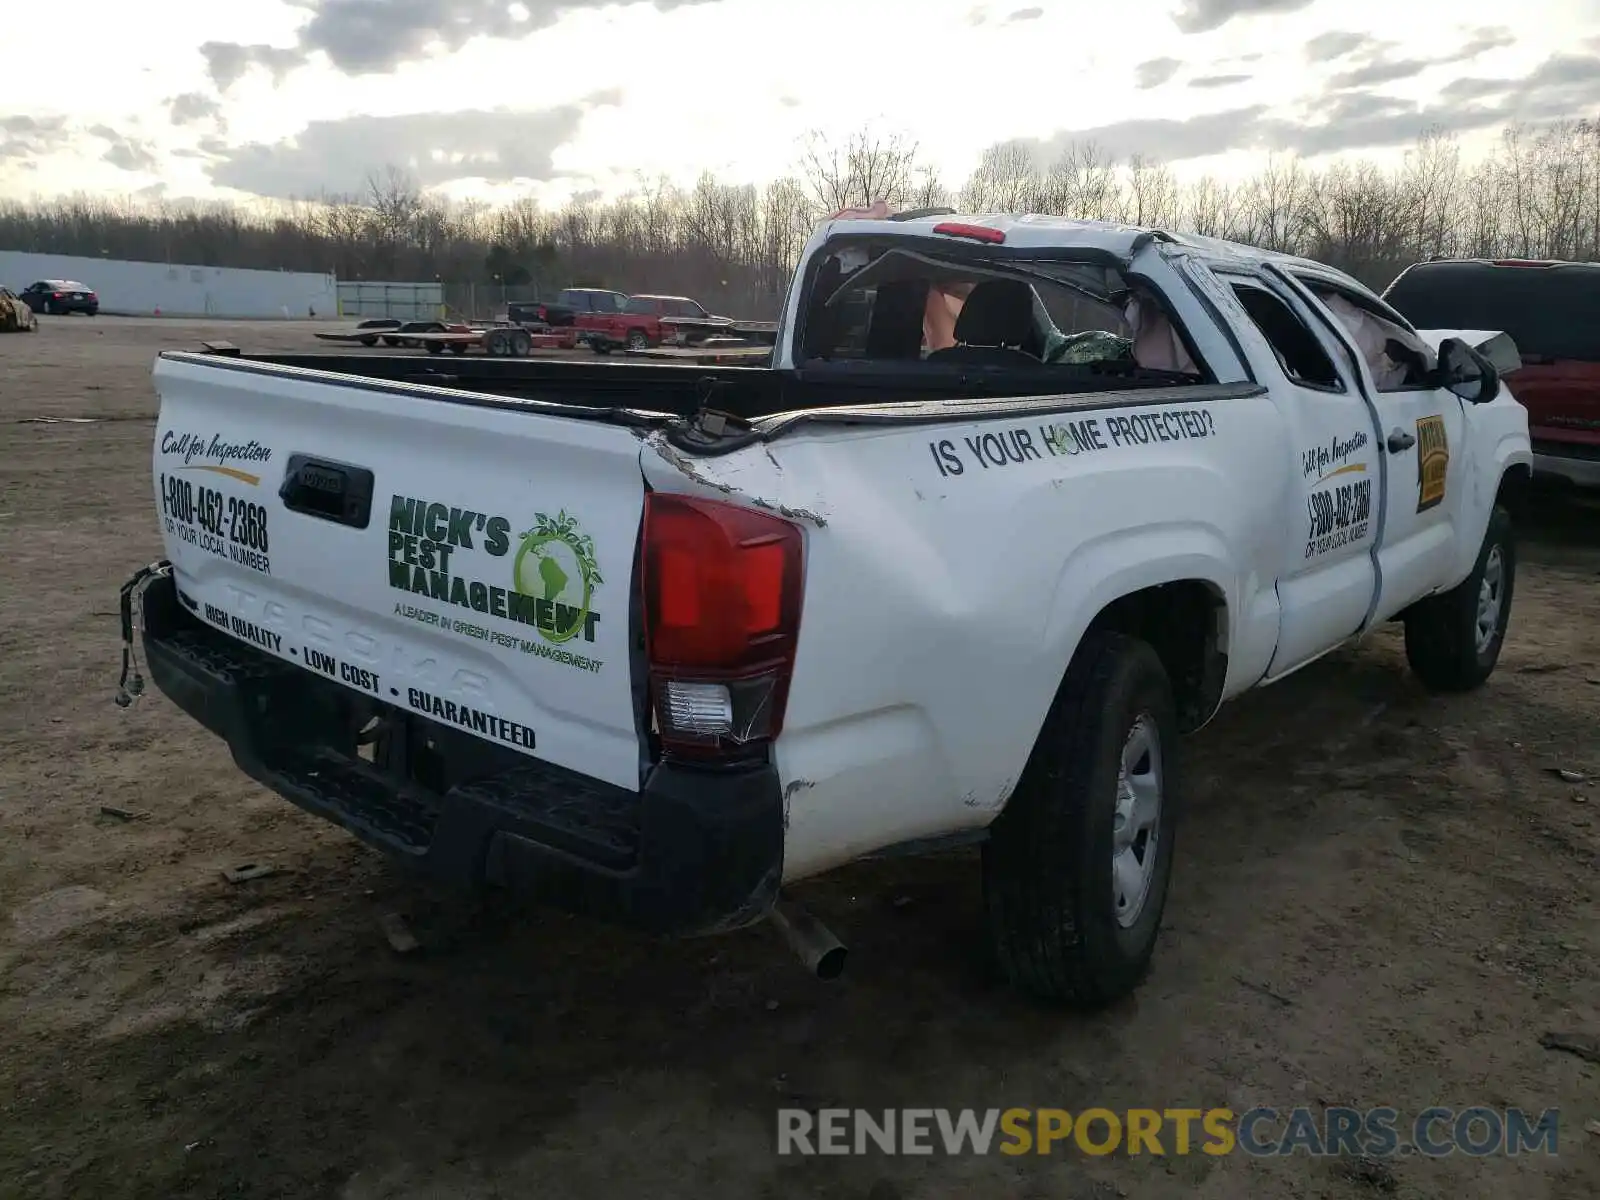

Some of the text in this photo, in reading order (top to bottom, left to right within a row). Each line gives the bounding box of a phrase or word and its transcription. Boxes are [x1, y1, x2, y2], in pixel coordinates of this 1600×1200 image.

[161, 430, 272, 465] Call for Inspection
[929, 439, 964, 477] IS
[965, 429, 1041, 469] YOUR
[1106, 409, 1216, 447] PROTECTED?
[1332, 431, 1368, 464] Inspection
[160, 473, 269, 552] 1-800-462-2368
[389, 494, 511, 556] NICK'S
[165, 517, 271, 575] OR YOUR LOCAL NUMBER
[388, 532, 454, 573] PEST
[389, 560, 600, 642] MANAGEMENT
[394, 603, 603, 673] A LEADER IN GREEN PEST MANAGEMENT
[204, 603, 536, 750] HIGH QUALITY LOW COST GUARANTEED
